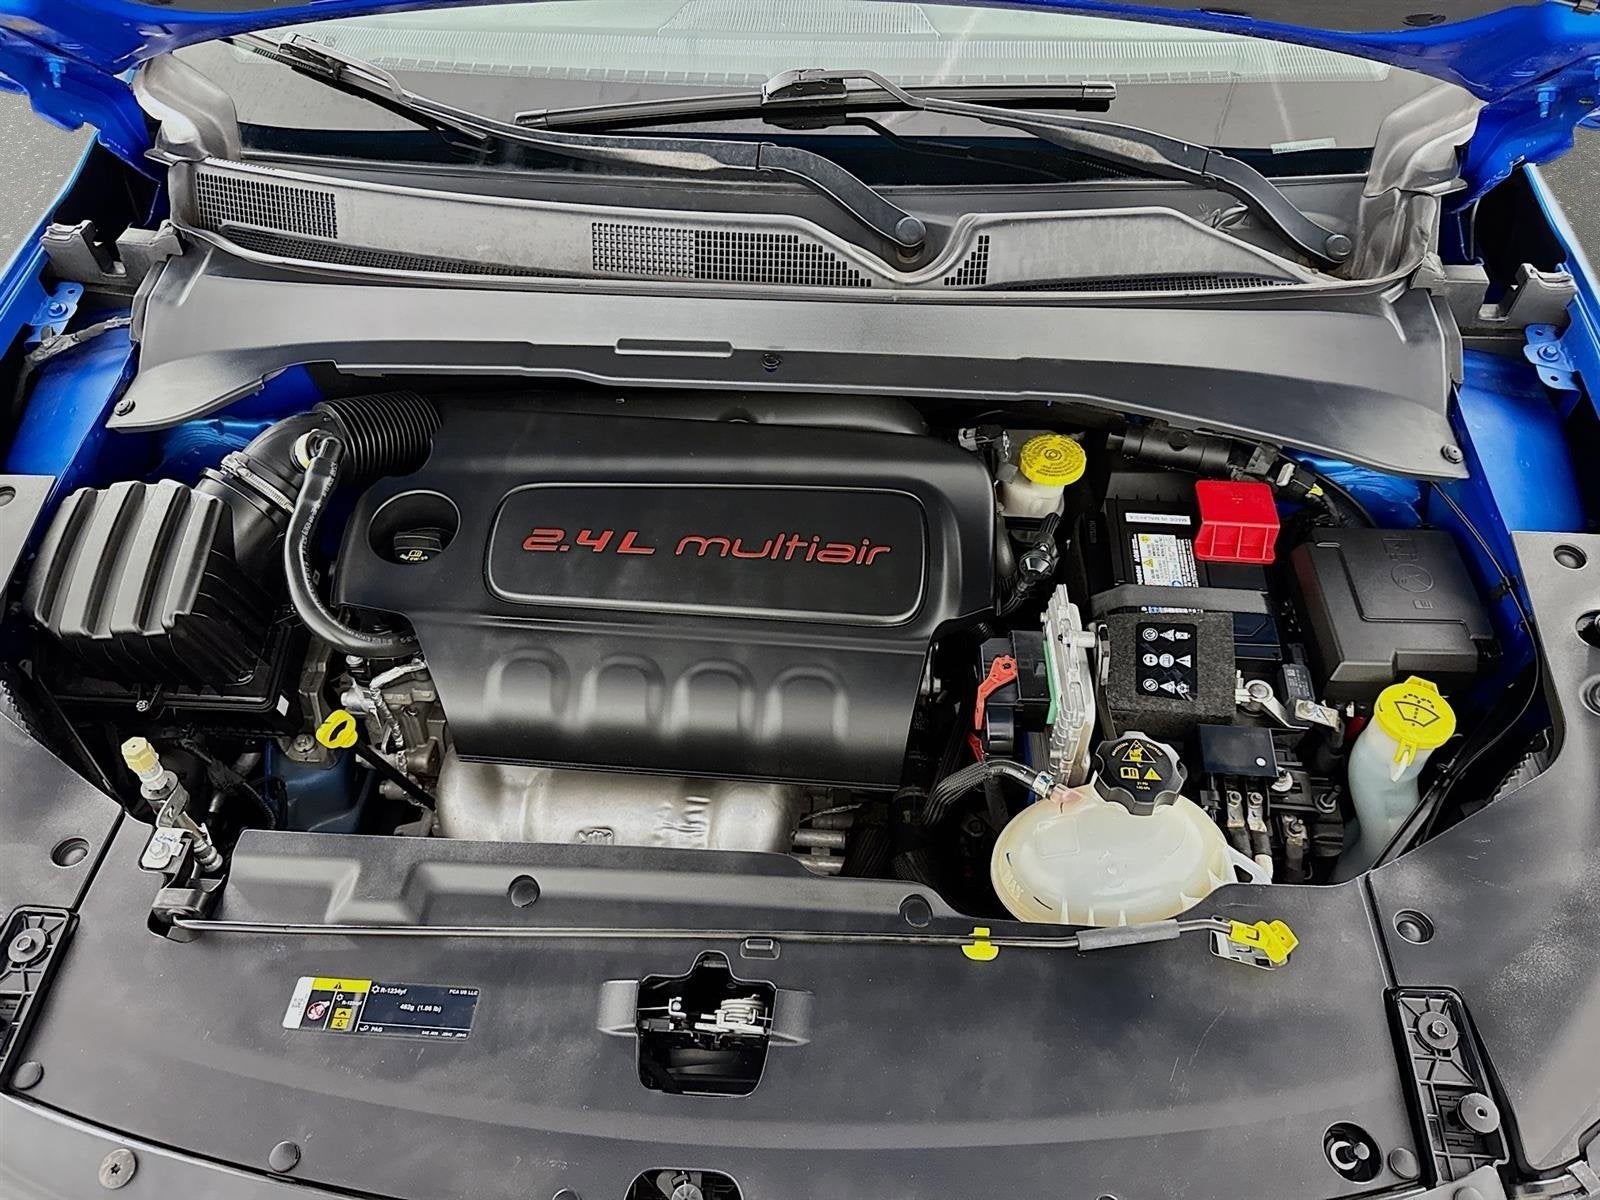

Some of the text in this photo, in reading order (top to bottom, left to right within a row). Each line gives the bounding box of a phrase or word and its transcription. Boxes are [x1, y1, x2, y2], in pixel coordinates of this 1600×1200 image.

[522, 528, 891, 566] 2.4L multiair
[379, 987, 408, 996] R-1234yf
